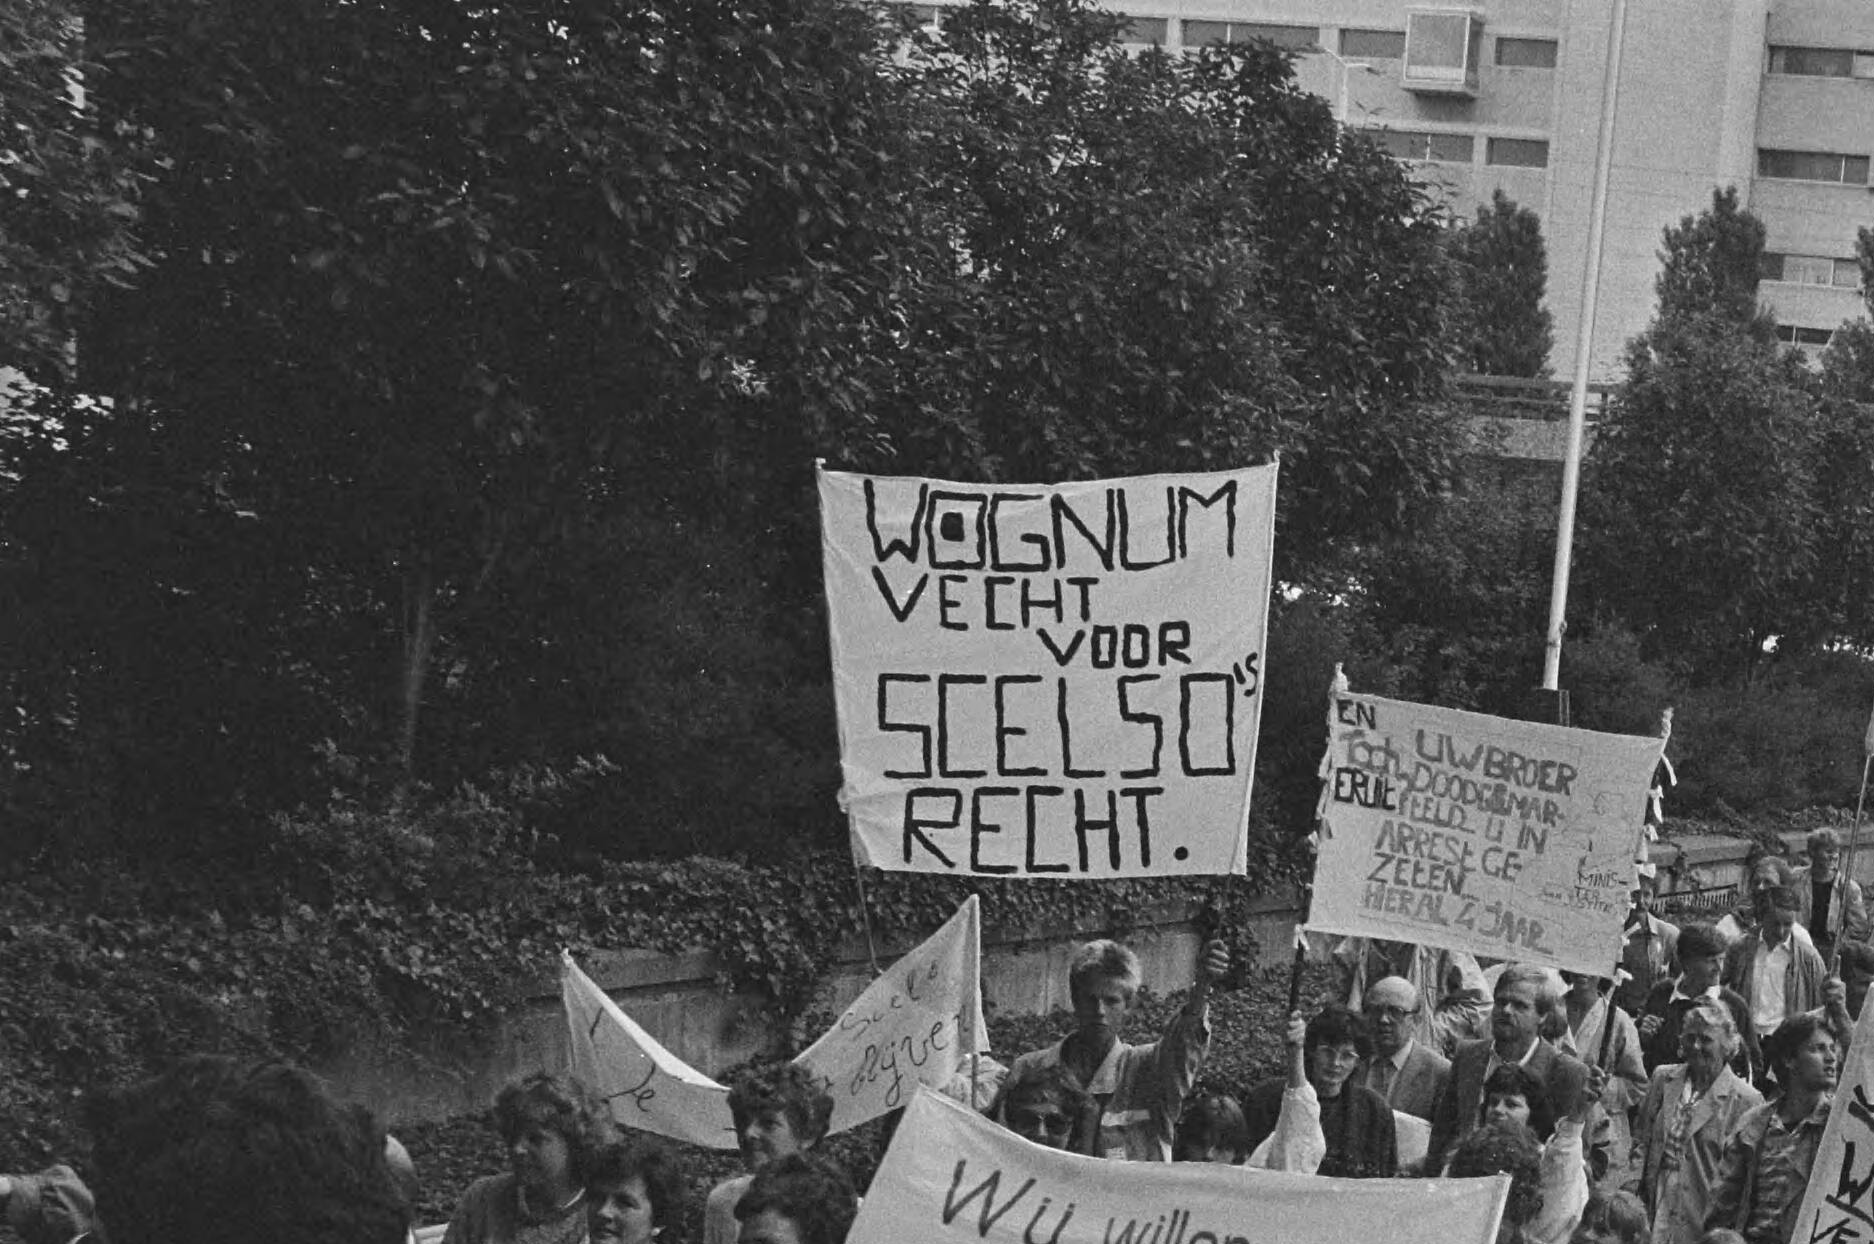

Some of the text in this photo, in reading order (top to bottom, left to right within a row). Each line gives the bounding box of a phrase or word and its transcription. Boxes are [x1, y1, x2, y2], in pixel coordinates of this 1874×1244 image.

[864, 479, 1237, 571] WOGNUM
[872, 566, 1099, 631] VECHT
[1036, 621, 1192, 669] VOOR
[1337, 699, 1376, 730] EN
[1416, 730, 1577, 796] UW BROER
[903, 785, 1189, 874] RECHT.
[1518, 822, 1547, 854] IN
